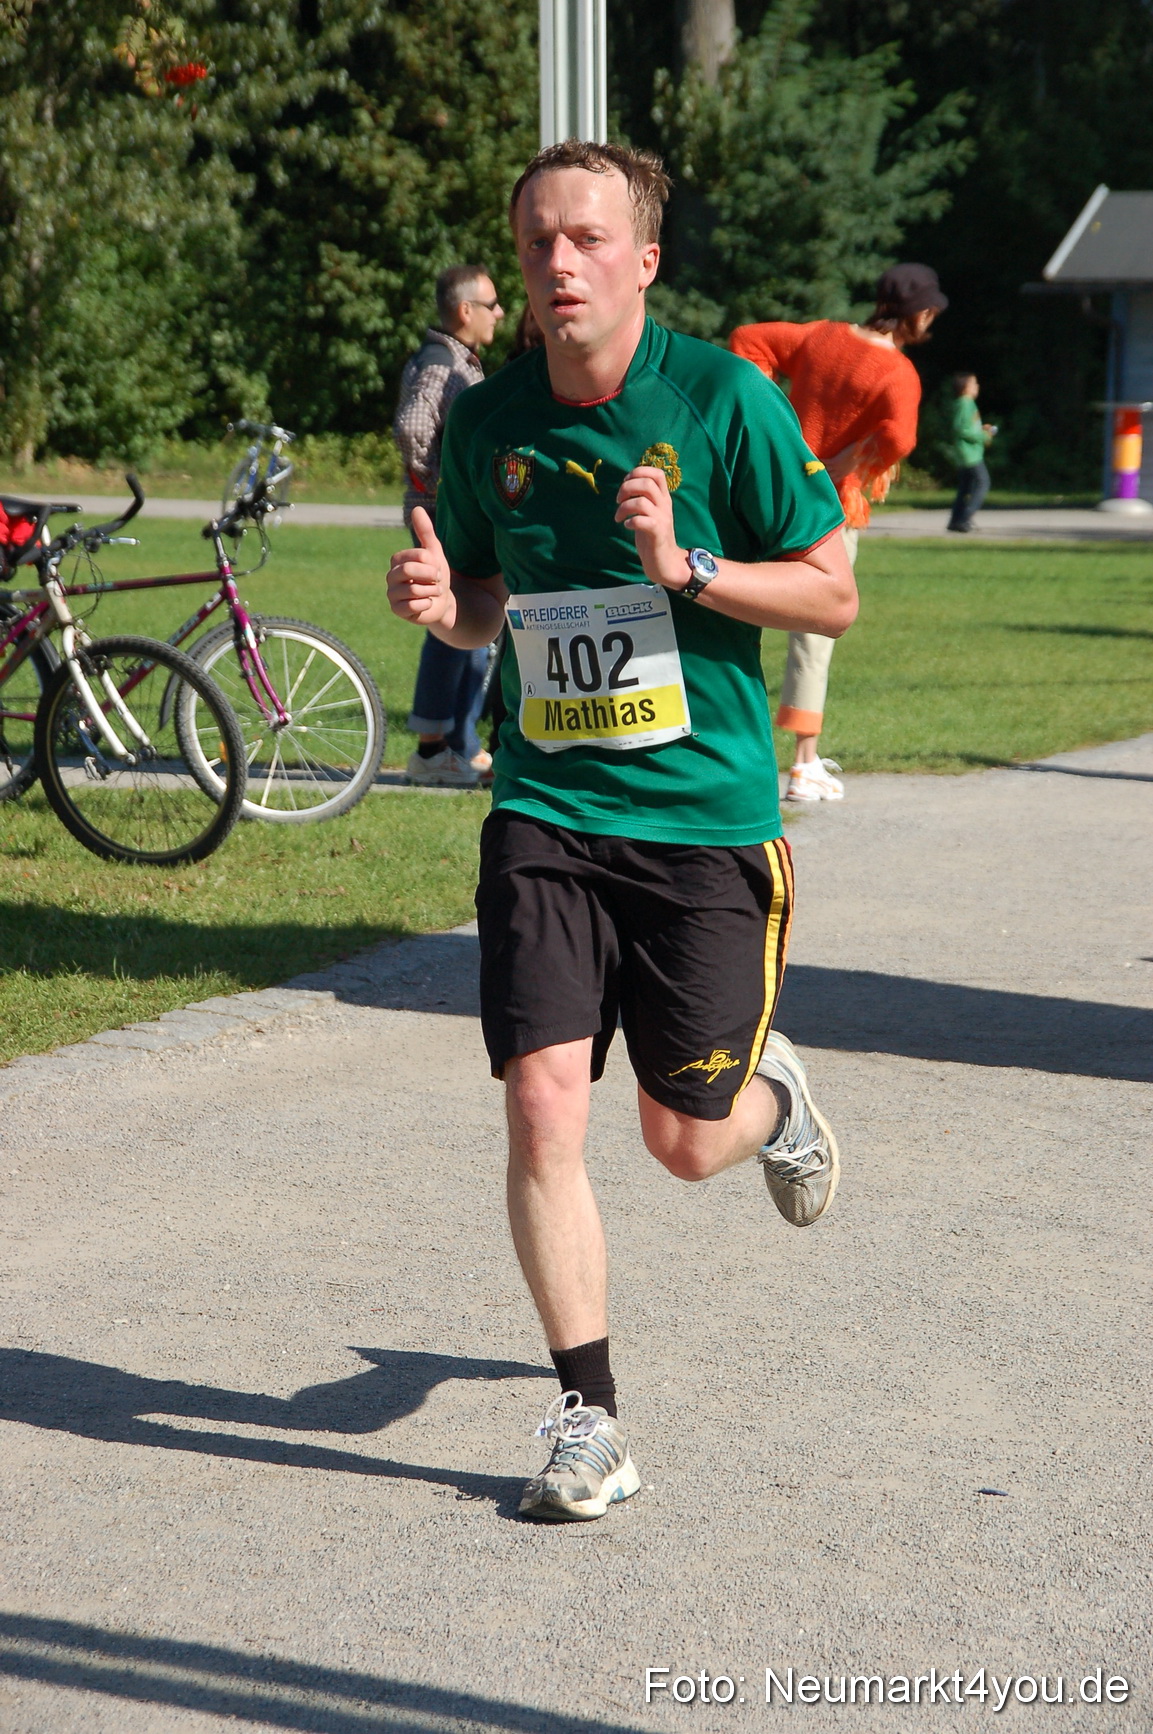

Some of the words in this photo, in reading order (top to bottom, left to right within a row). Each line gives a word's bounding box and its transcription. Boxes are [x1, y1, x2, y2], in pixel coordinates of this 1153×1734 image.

[522, 605, 589, 622] PFLEIDERER
[605, 601, 653, 618] BOCK
[526, 621, 590, 631] AKTIENGESELLSCHAFT
[547, 631, 639, 693] 402
[527, 684, 533, 696] A
[544, 698, 656, 732] Mathias
